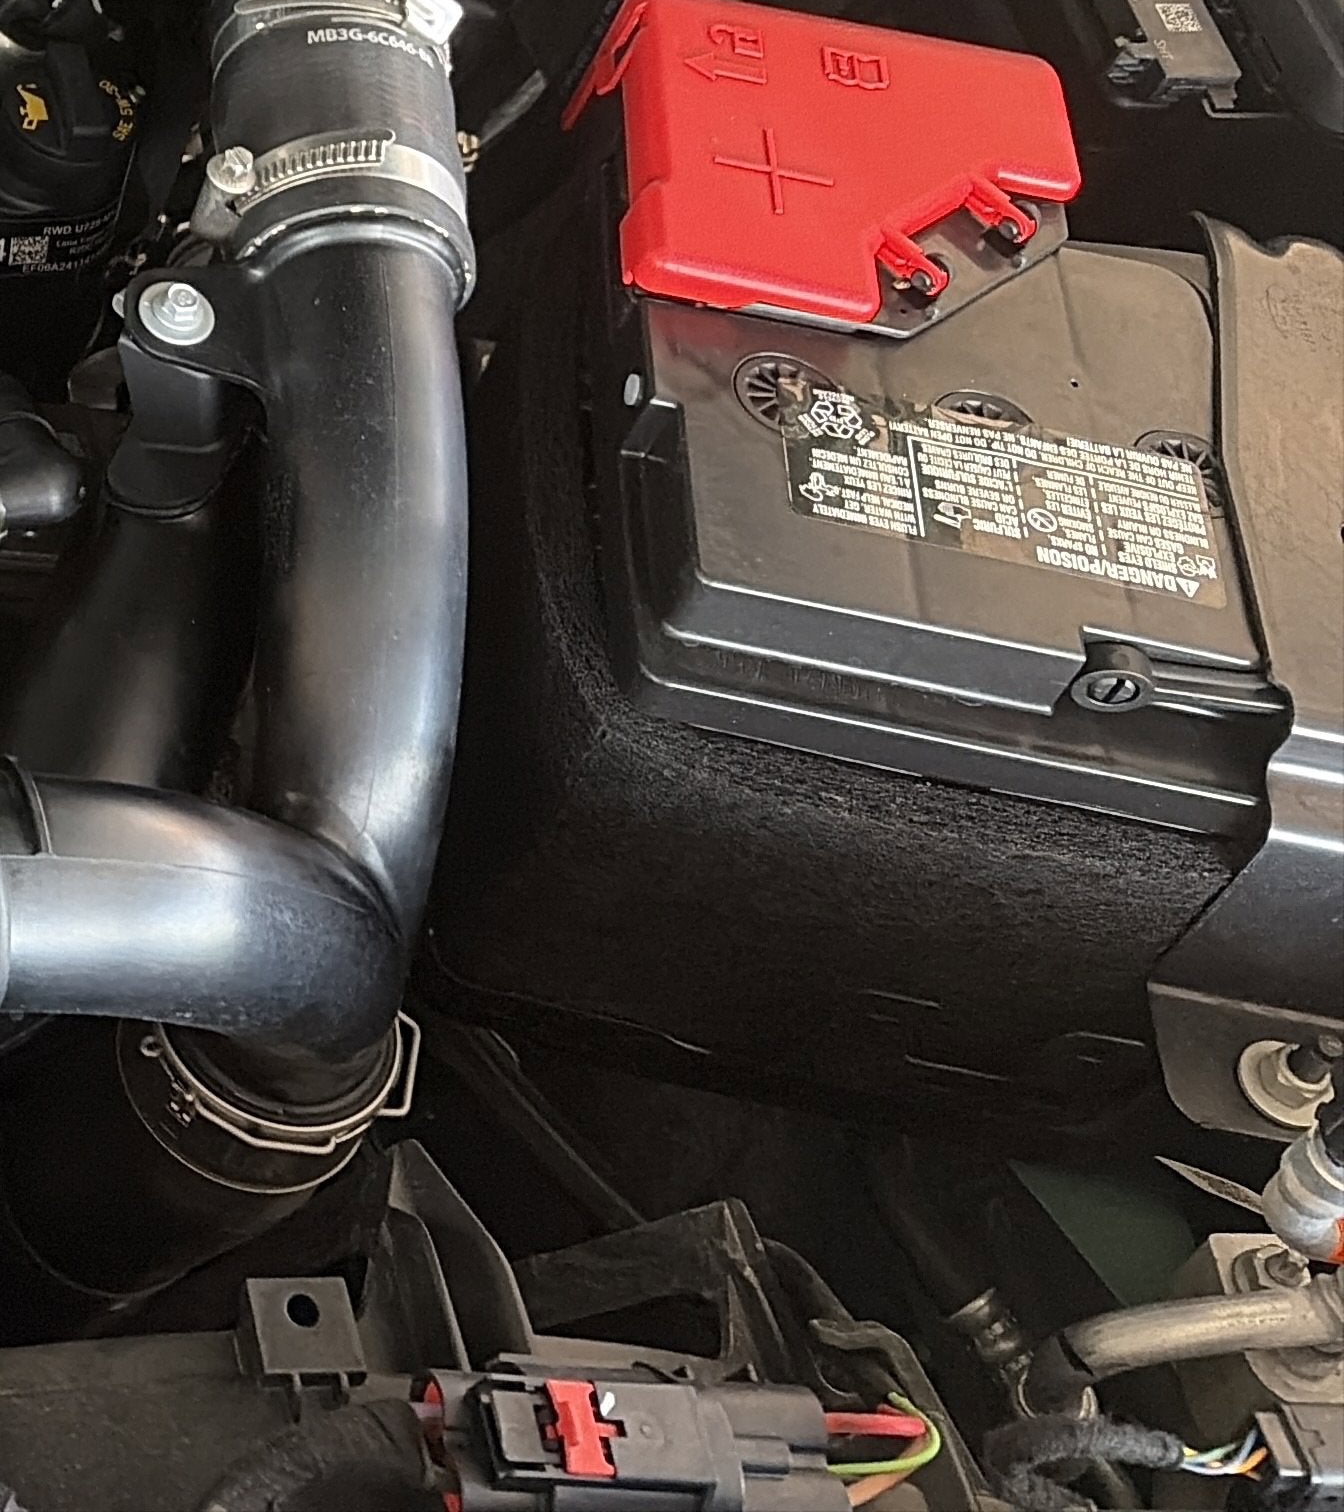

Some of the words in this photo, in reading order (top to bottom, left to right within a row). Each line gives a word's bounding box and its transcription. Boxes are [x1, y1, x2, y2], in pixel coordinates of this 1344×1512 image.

[111, 120, 133, 142] SAE
[43, 225, 71, 234] RWD
[930, 428, 951, 442] OPEN
[955, 433, 969, 446] NOT
[983, 427, 999, 440] PAS
[1007, 443, 1022, 455] NOT
[1059, 444, 1075, 457] DES
[1111, 446, 1122, 458] LA
[994, 457, 1007, 468] DES
[1125, 449, 1158, 466] OUVRIR
[1161, 457, 1176, 470] PAS
[862, 456, 908, 478] CONSULTEZ
[965, 460, 990, 475] CAUSER
[993, 466, 1009, 479] PEUT
[1098, 464, 1124, 478] REACH
[1143, 463, 1165, 478] HORS
[843, 474, 863, 488] YEUX
[880, 472, 899, 486] L'EAU
[1127, 470, 1141, 482] THE
[867, 479, 879, 492] LES
[935, 477, 963, 494] BURNS
[1158, 477, 1173, 490] OUT
[1176, 481, 1195, 495] KEEP
[862, 491, 878, 504] HELP
[922, 485, 967, 506] BLINDNESS
[967, 485, 998, 501] SEVERE
[1072, 485, 1086, 497] LES
[845, 498, 859, 511] GET
[881, 495, 913, 512] MEDICAL
[971, 496, 995, 511] CAUSE
[1045, 499, 1059, 511] LES
[1108, 492, 1139, 509] PEUVENT
[813, 502, 866, 524] IMMEDIATELY
[999, 502, 1016, 516] CAN
[1101, 501, 1115, 515] LES
[1119, 505, 1141, 520] YEUX
[869, 514, 887, 529] EYES
[894, 509, 915, 524] WITH
[995, 511, 1017, 527] ACID
[1144, 511, 1159, 524] LES
[1187, 510, 1203, 523] GAZ
[891, 519, 916, 536] FLUSH
[973, 517, 1020, 539] SULFURIC
[1118, 518, 1146, 534] INJURY
[1107, 526, 1132, 542] CAUSE
[1135, 533, 1151, 546] CAN
[1163, 528, 1207, 548] BLINDNESS
[1084, 543, 1097, 556] NO
[1124, 540, 1174, 563] EXPLOSIVE
[1154, 537, 1183, 554] GASES
[1118, 550, 1141, 566] EYES
[1145, 556, 1176, 574] SHIELD
[1037, 544, 1175, 593] DANGER/POISON
